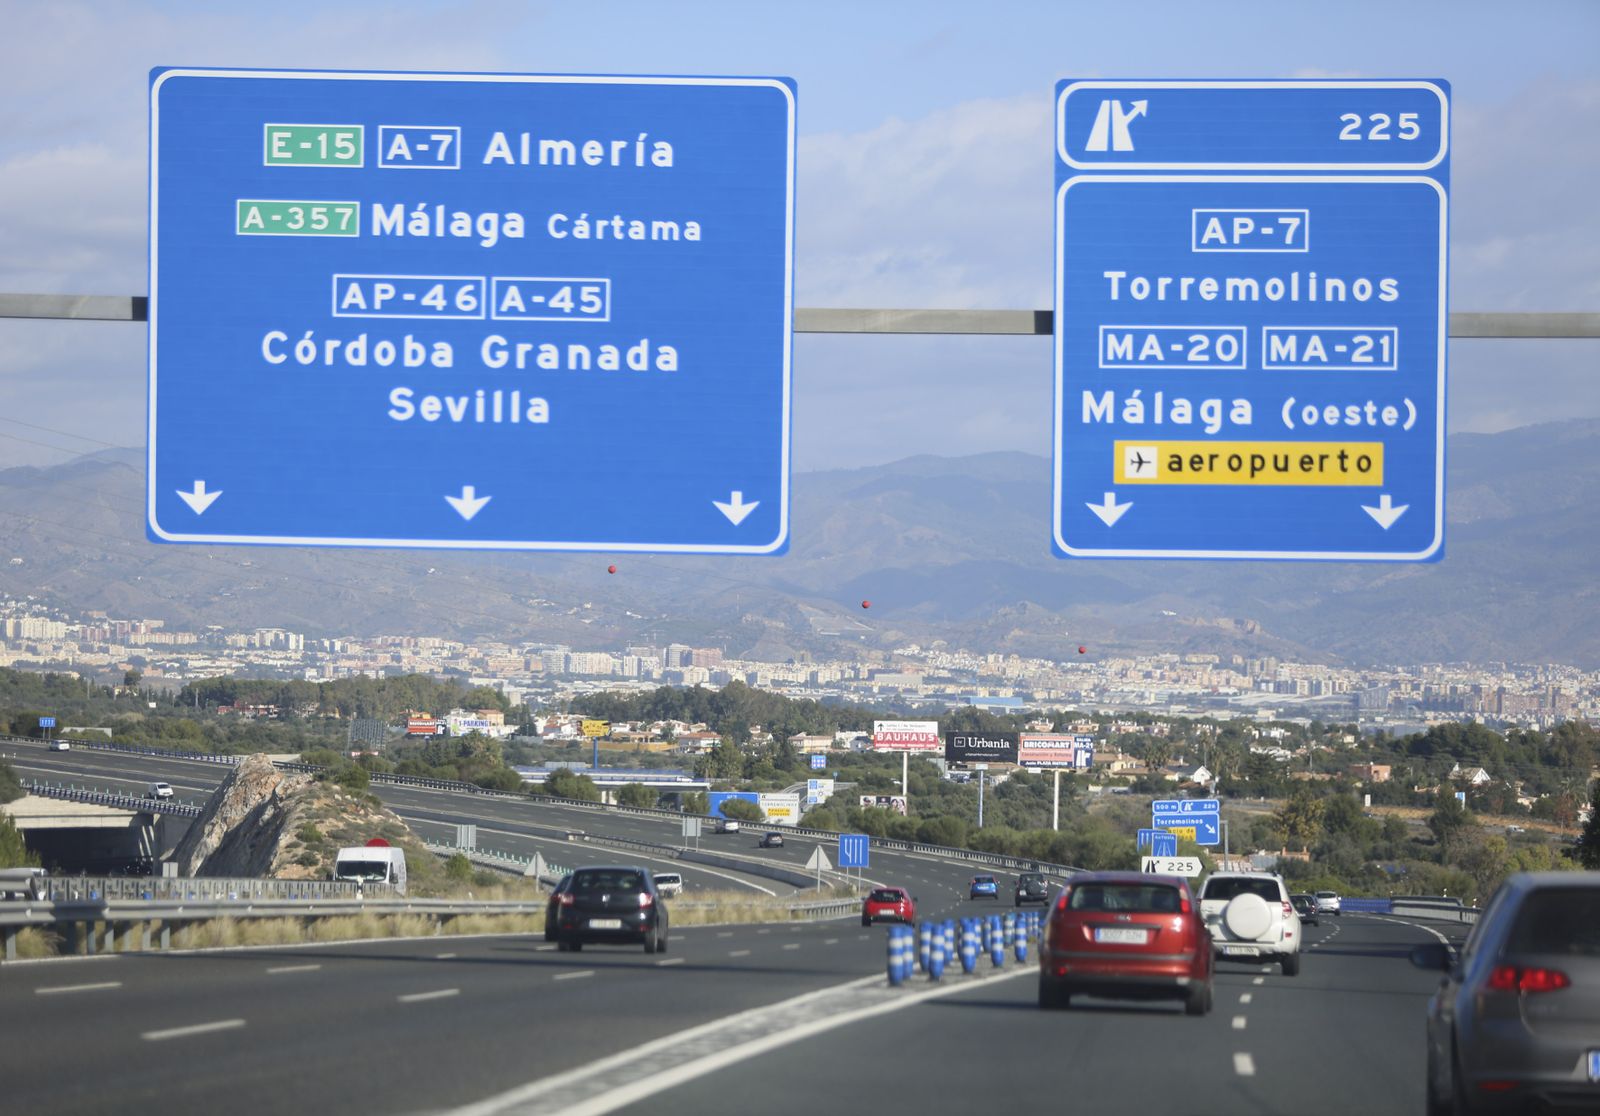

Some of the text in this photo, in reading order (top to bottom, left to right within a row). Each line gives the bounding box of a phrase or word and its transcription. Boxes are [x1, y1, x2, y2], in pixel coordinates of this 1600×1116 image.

[1339, 112, 1421, 141] 225
[271, 131, 674, 168] E-15 A-7 Almería
[243, 202, 702, 248] A-357 Málaga Cártama
[1200, 216, 1301, 245] AP-7
[340, 282, 603, 314] AP-46 A-45
[1103, 270, 1400, 302] Torremolinos
[261, 330, 679, 372] Córdoba Granada
[1106, 333, 1391, 363] MA-20 MA-21
[387, 386, 550, 424] Sevilla
[1081, 389, 1418, 435] Málaga (oeste)
[1167, 449, 1373, 479] aeropuerto
[877, 732, 935, 742] BAUHAUS
[967, 736, 1010, 748] Urbania
[1023, 741, 1070, 749] BRICOMART
[1167, 862, 1194, 871] 225
